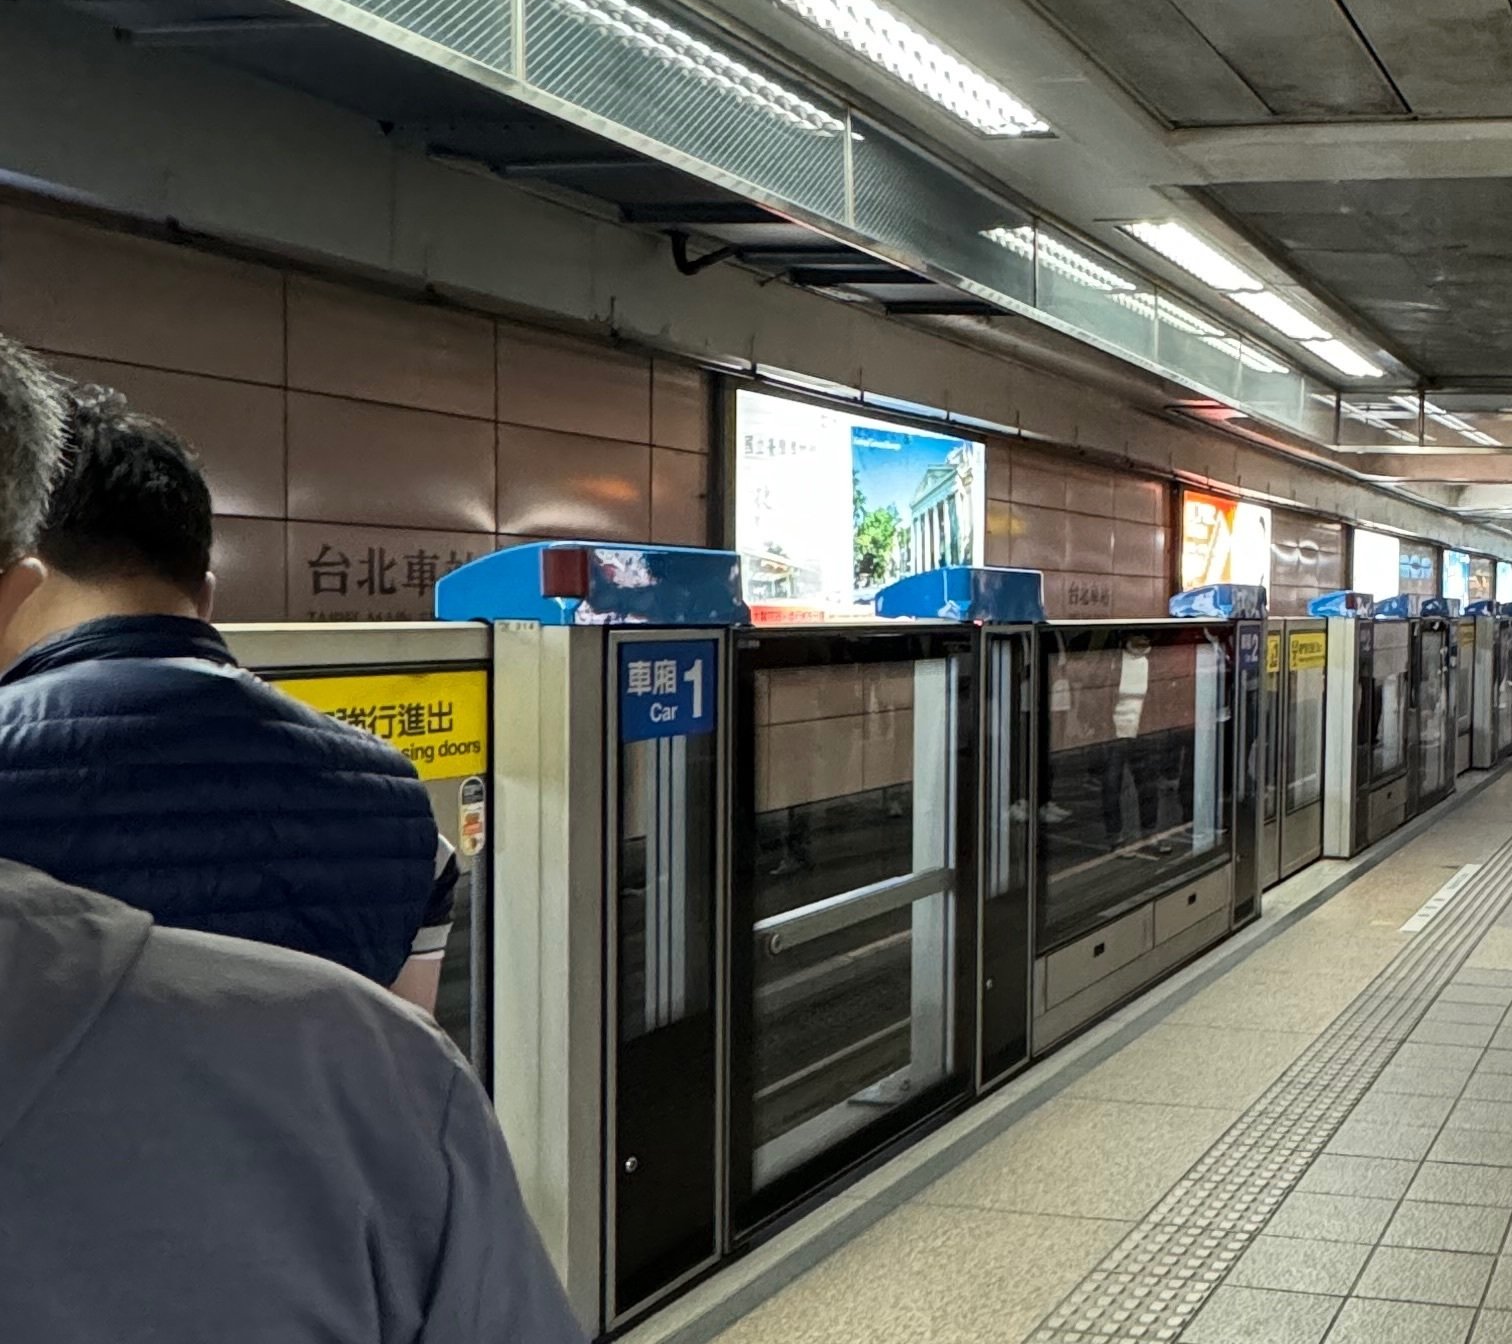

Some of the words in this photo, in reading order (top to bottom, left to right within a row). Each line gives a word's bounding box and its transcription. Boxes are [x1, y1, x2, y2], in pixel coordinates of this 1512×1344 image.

[626, 659, 677, 696] 車廂
[683, 658, 703, 719] 1
[322, 701, 454, 740] 強行進出
[650, 703, 678, 723] Car
[401, 743, 435, 763] sing
[437, 740, 481, 758] doors
